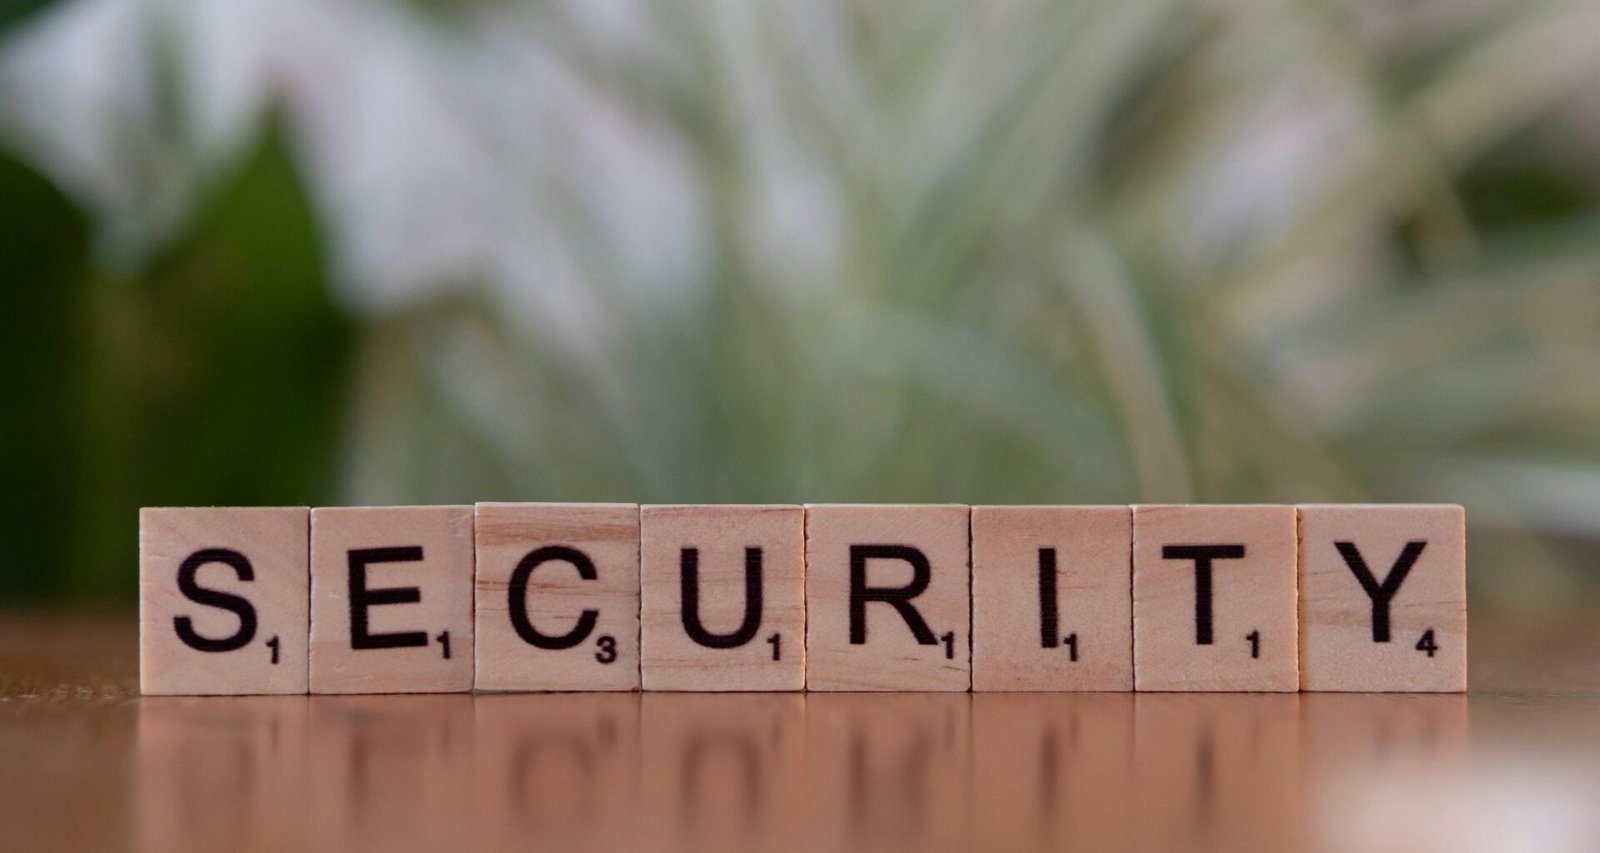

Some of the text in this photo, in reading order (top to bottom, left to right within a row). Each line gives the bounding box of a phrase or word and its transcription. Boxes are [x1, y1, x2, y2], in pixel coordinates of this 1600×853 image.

[173, 540, 1428, 653] SECURITY
[265, 635, 280, 665] 1
[435, 630, 452, 660] 1
[594, 635, 619, 665] 3
[766, 632, 781, 662] 1
[940, 631, 955, 660] 1
[1062, 633, 1079, 663] 1
[1245, 630, 1260, 660] 1
[1415, 628, 1439, 658] 4
